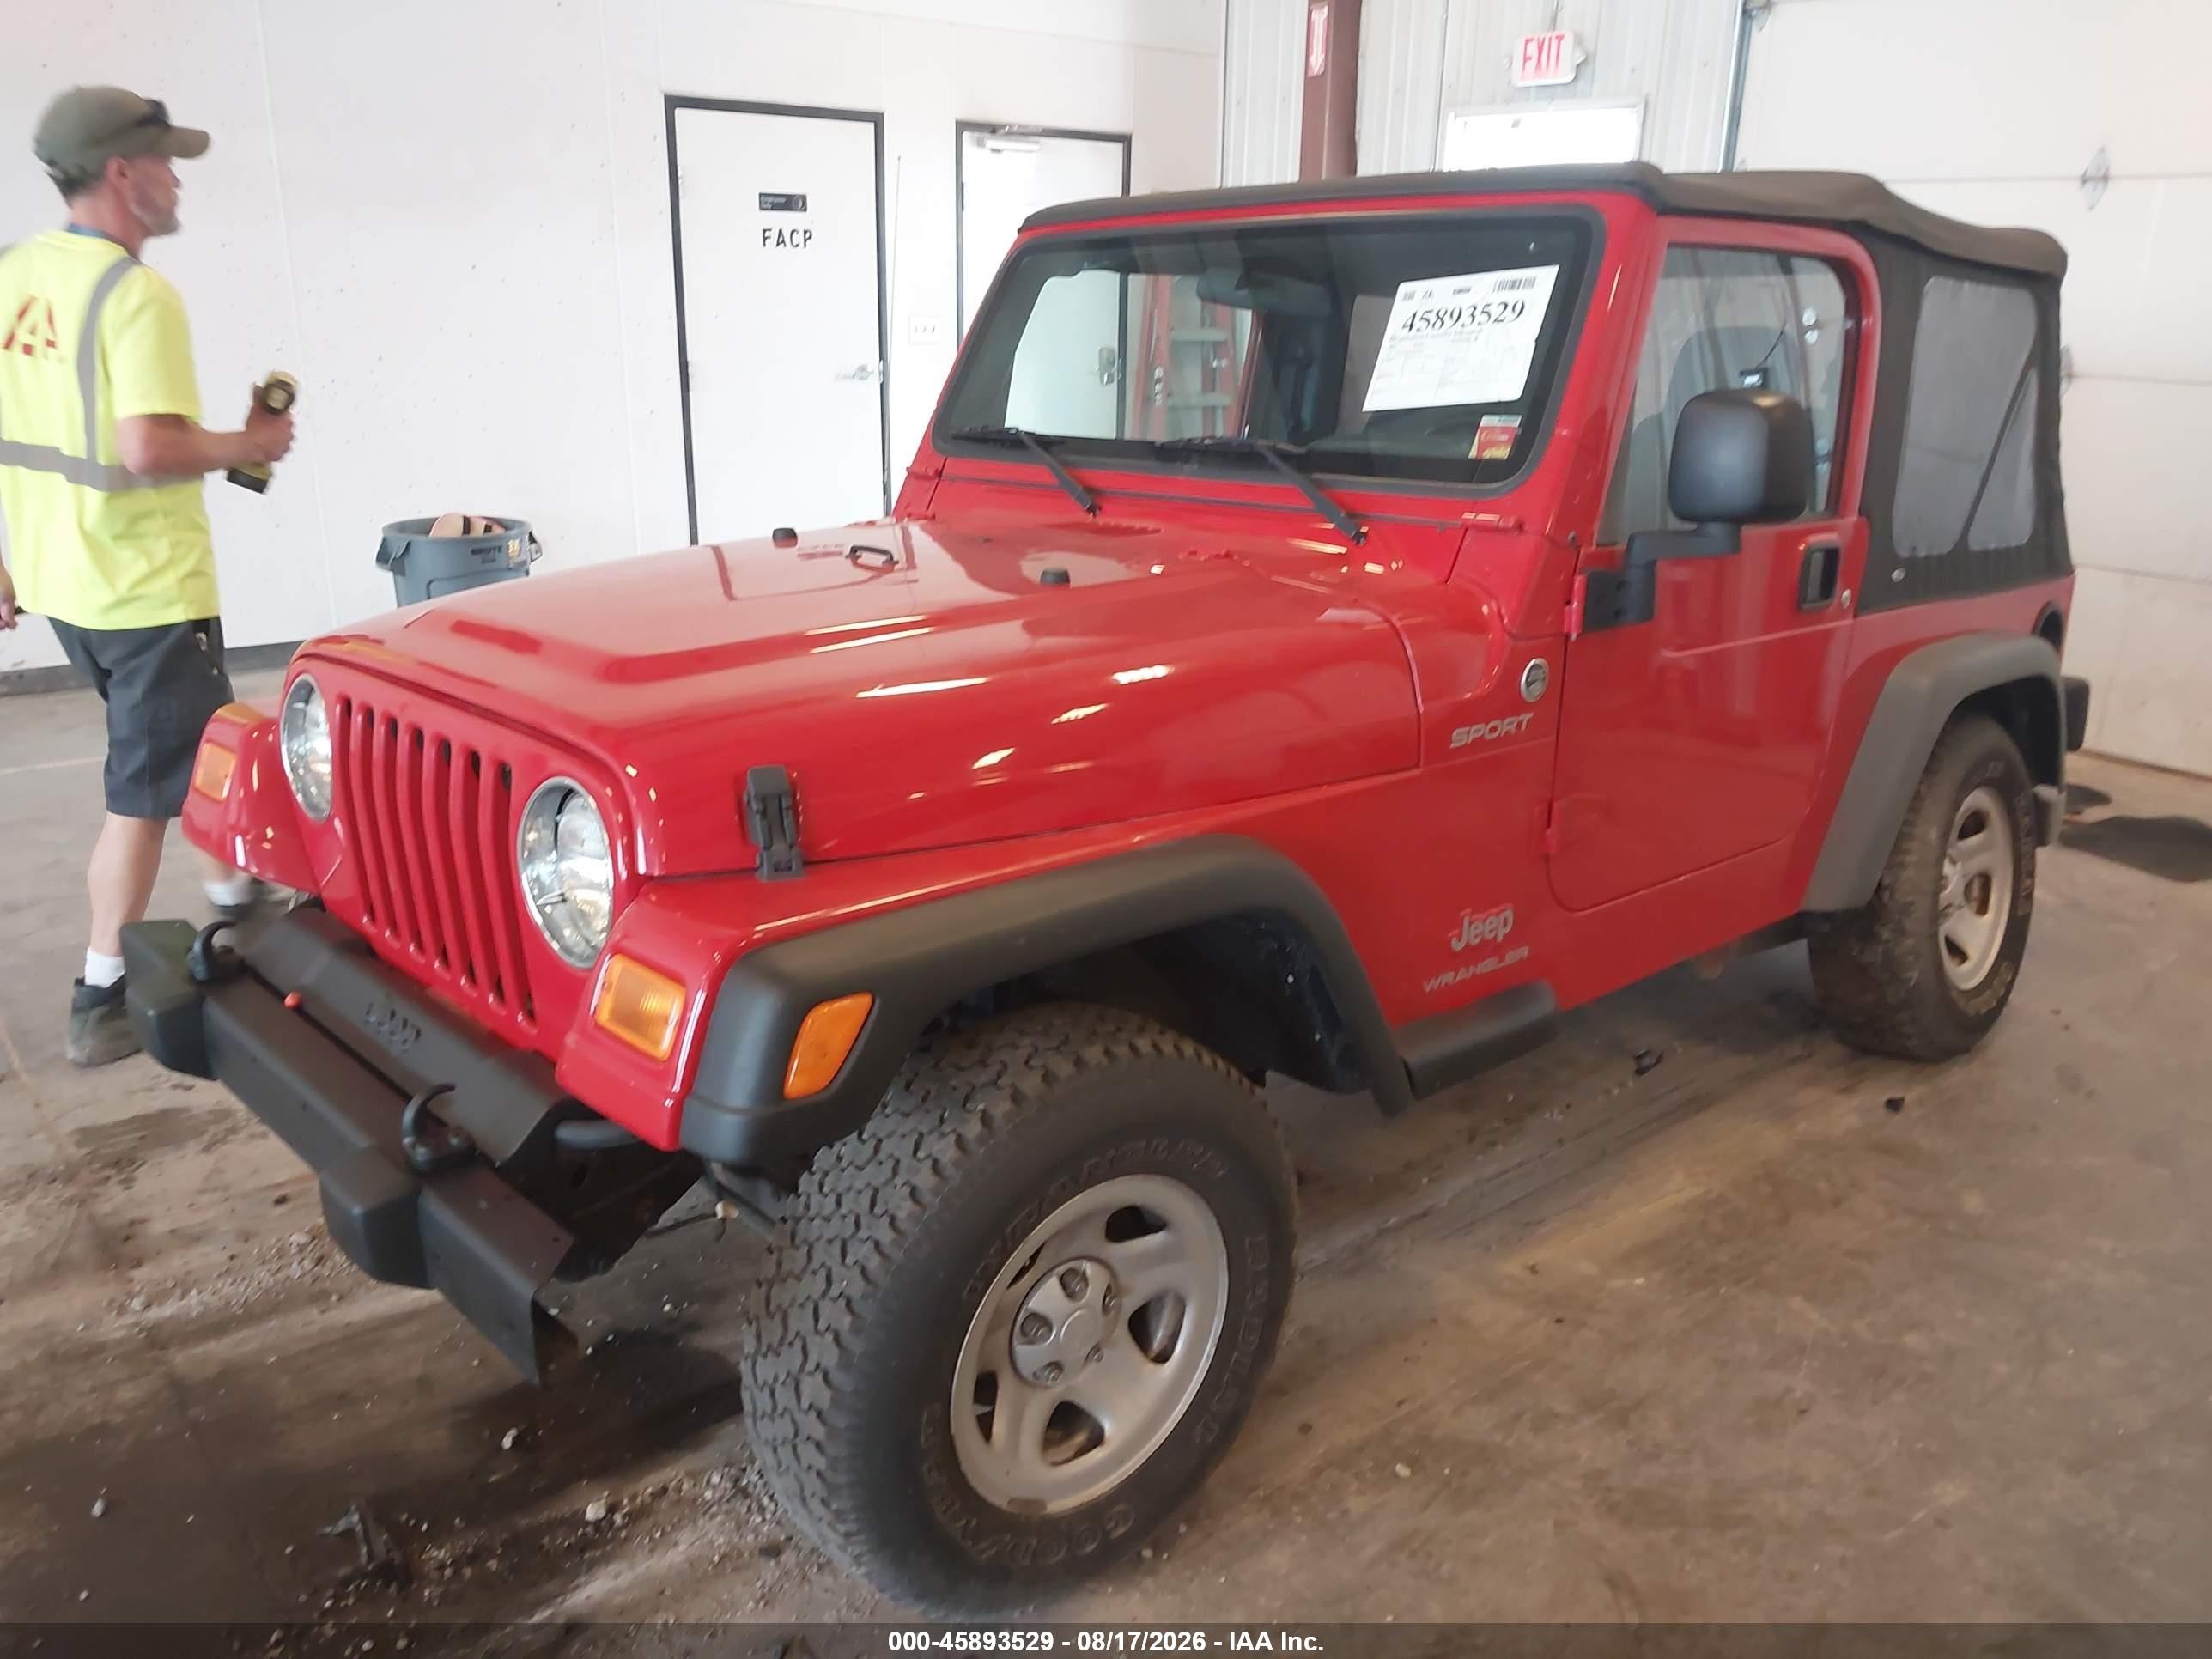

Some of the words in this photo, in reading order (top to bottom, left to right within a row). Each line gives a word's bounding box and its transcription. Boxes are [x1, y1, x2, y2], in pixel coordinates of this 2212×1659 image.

[1521, 34, 1566, 77] EXIT
[762, 228, 813, 248] FACP
[1402, 301, 1525, 332] 45893529
[1449, 712, 1534, 749] SPORT
[1450, 907, 1514, 952] Jeep
[1423, 945, 1529, 993] WRANGLER
